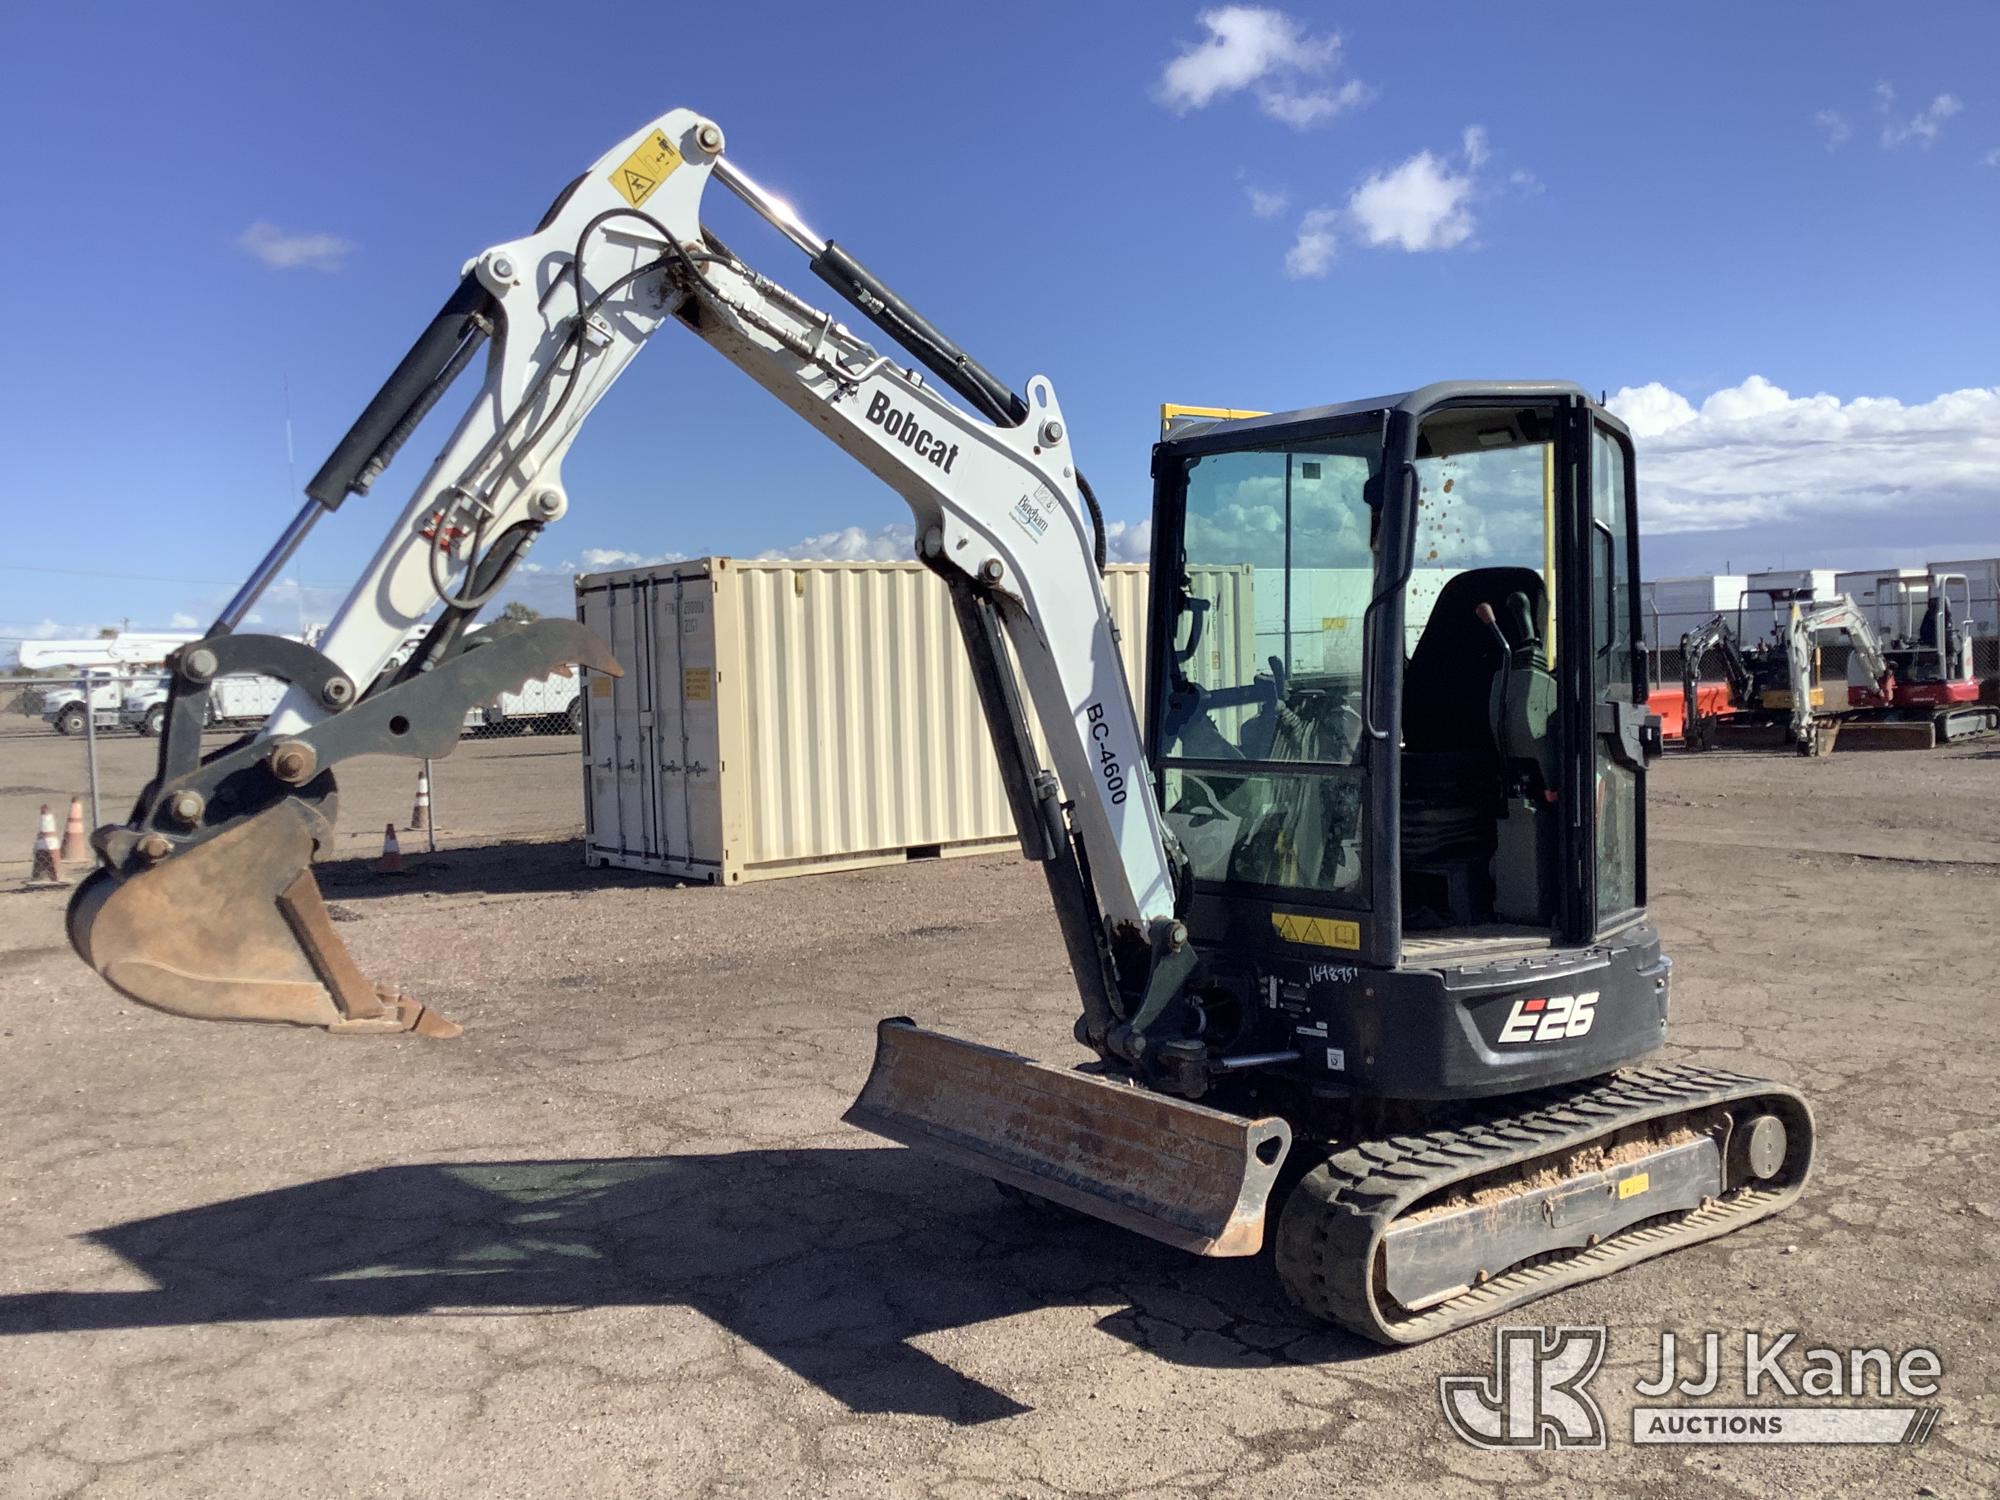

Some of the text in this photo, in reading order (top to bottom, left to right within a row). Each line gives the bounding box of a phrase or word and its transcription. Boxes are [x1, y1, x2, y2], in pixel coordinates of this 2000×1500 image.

[865, 389, 959, 475] Bobcat
[1018, 494, 1049, 532] Bingham
[1086, 702, 1127, 805] BC-4600
[1497, 991, 1600, 1043] E26
